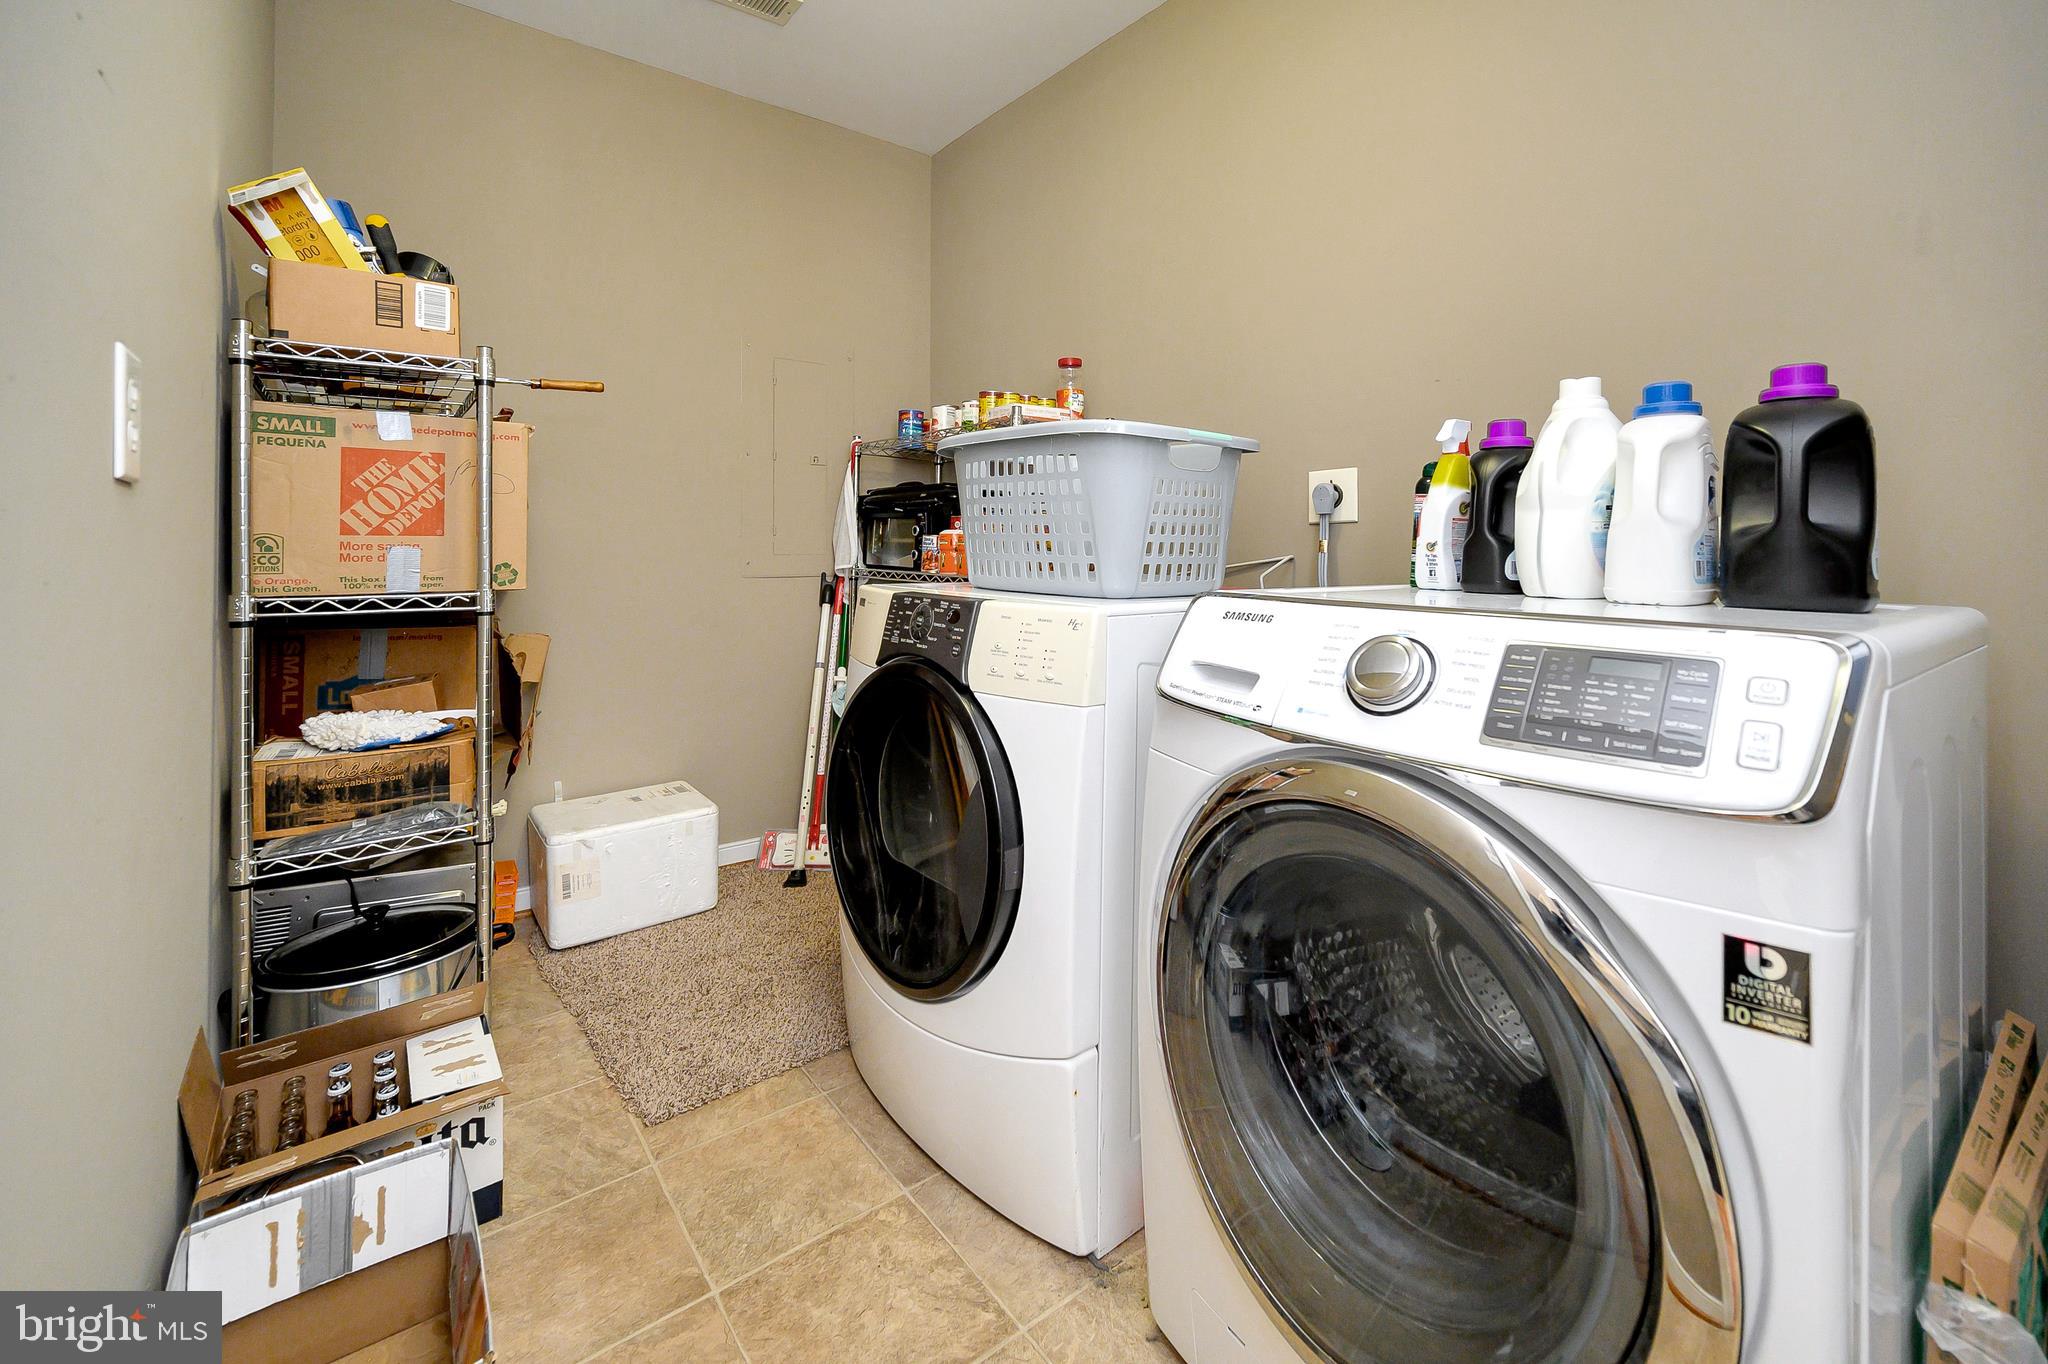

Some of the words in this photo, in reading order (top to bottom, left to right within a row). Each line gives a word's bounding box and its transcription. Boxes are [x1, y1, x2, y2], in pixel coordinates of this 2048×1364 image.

[296, 244, 321, 262] 000
[256, 415, 326, 434] SMALL
[256, 435, 327, 449] PEQUEÑA
[350, 457, 397, 493] THE
[340, 452, 446, 536] HOME
[381, 482, 445, 536] DEPOT
[340, 541, 373, 551] More
[340, 553, 373, 563] More
[265, 577, 312, 586] Orange.
[361, 575, 381, 583] box
[282, 585, 321, 593] Green.
[1222, 610, 1275, 624] SAMSUNG
[281, 641, 300, 716] SMALL
[317, 773, 405, 791] www.cabelas.com
[1737, 974, 1795, 998] DIGITAL
[1730, 982, 1802, 1010] INVERTER
[1726, 1002, 1752, 1025] 10
[478, 1101, 496, 1112] PACK
